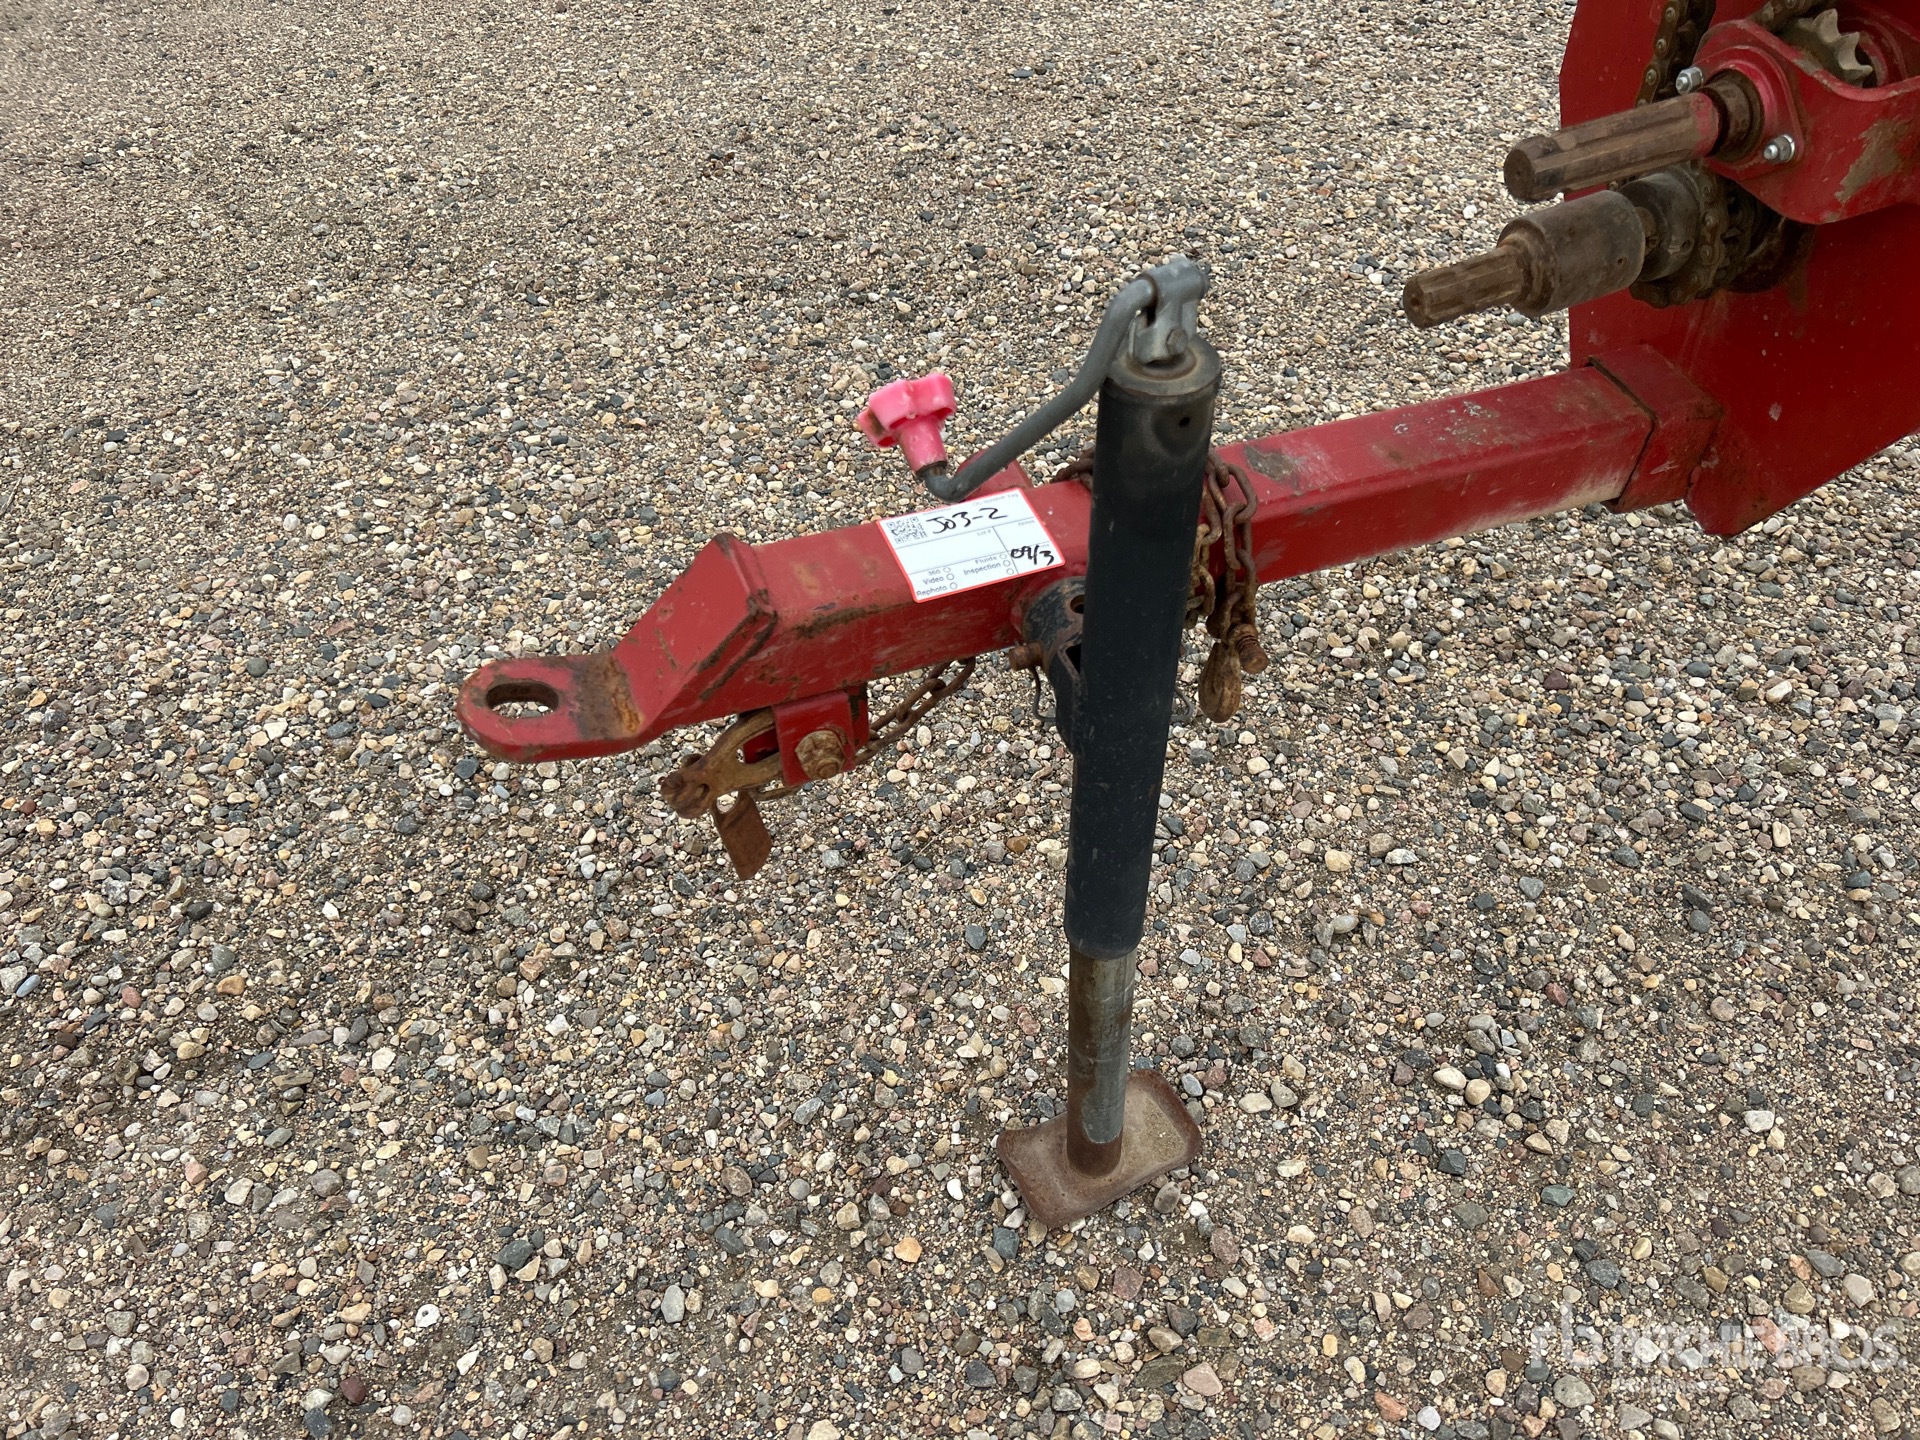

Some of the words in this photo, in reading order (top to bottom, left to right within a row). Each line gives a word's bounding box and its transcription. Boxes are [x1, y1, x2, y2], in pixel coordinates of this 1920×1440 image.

[974, 555, 998, 565] Fluids
[963, 562, 1002, 576] Inspection
[922, 575, 944, 585] Video
[916, 585, 948, 597] Rephoto
